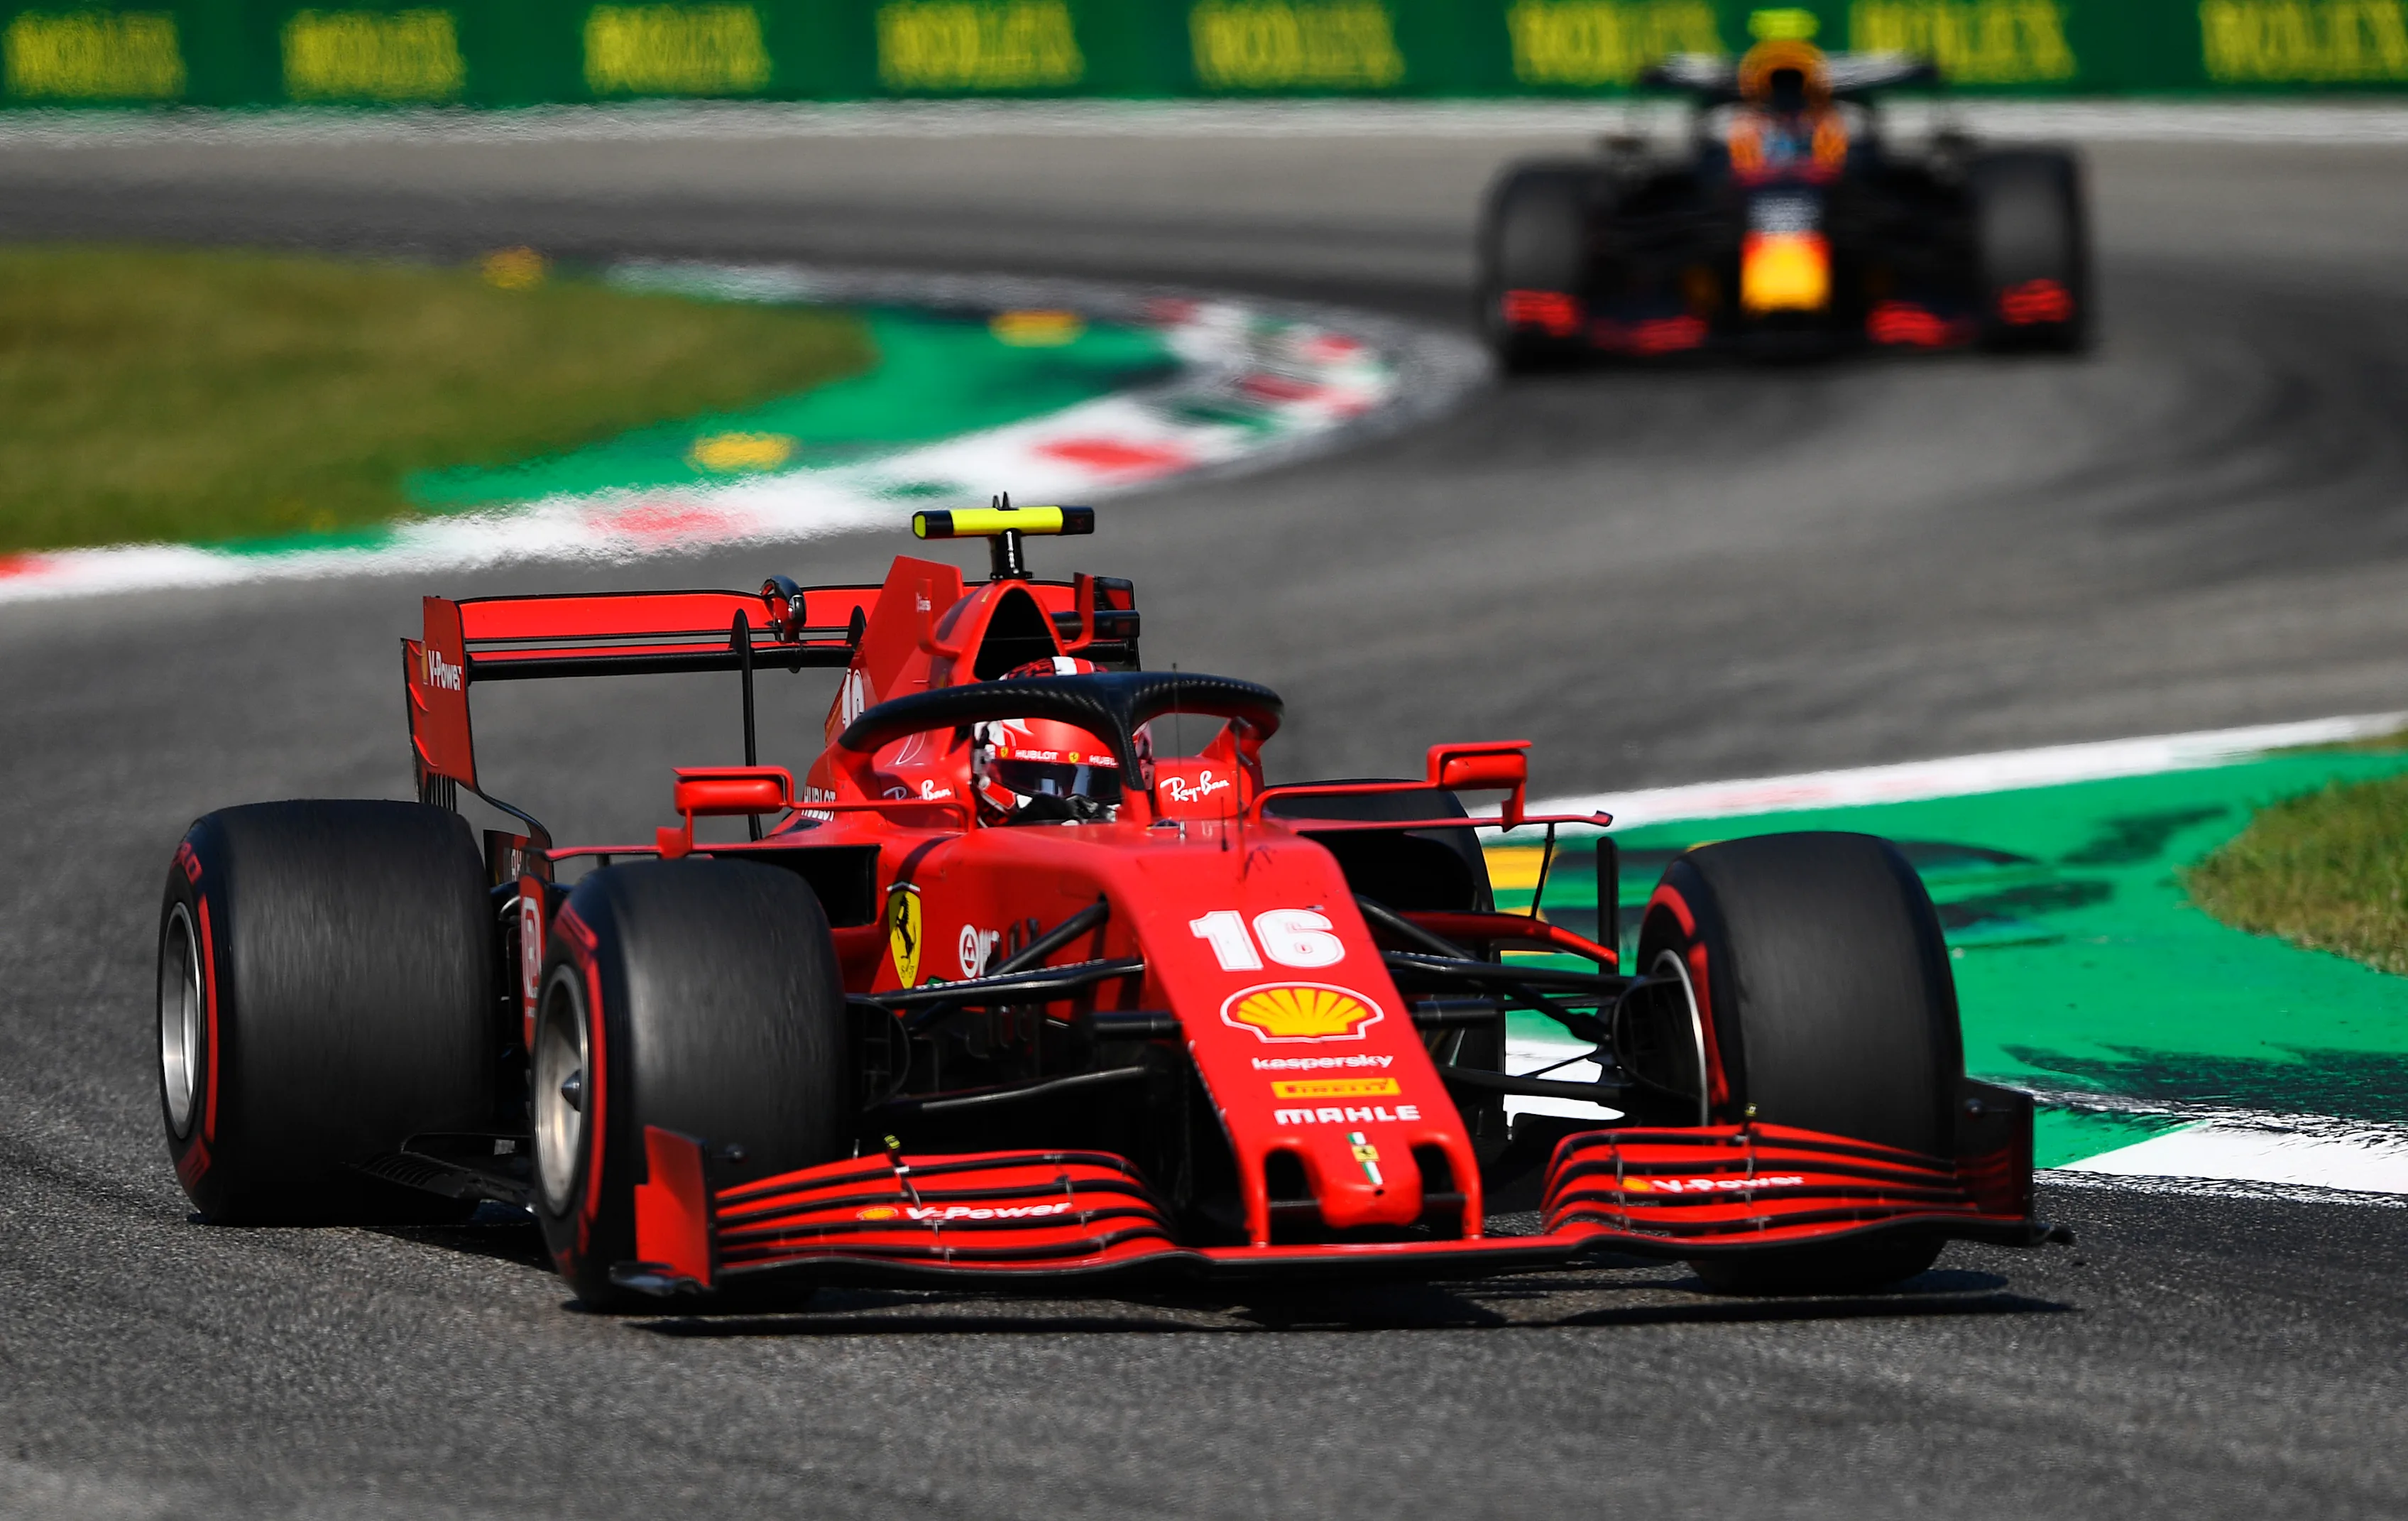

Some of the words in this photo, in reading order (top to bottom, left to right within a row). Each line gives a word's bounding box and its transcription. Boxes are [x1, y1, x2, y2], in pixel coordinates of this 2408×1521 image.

[427, 649, 462, 691] V-Power
[1015, 749, 1058, 760] HUBLOT
[1089, 755, 1119, 766] HUBL
[1160, 770, 1230, 802] Ray-Ban
[1188, 908, 1346, 972] 16
[1251, 1054, 1394, 1071] kaspersky
[1274, 1105, 1421, 1125] MAHLE
[1651, 1176, 1804, 1194] V-Power
[905, 1201, 1073, 1220] V-Power
